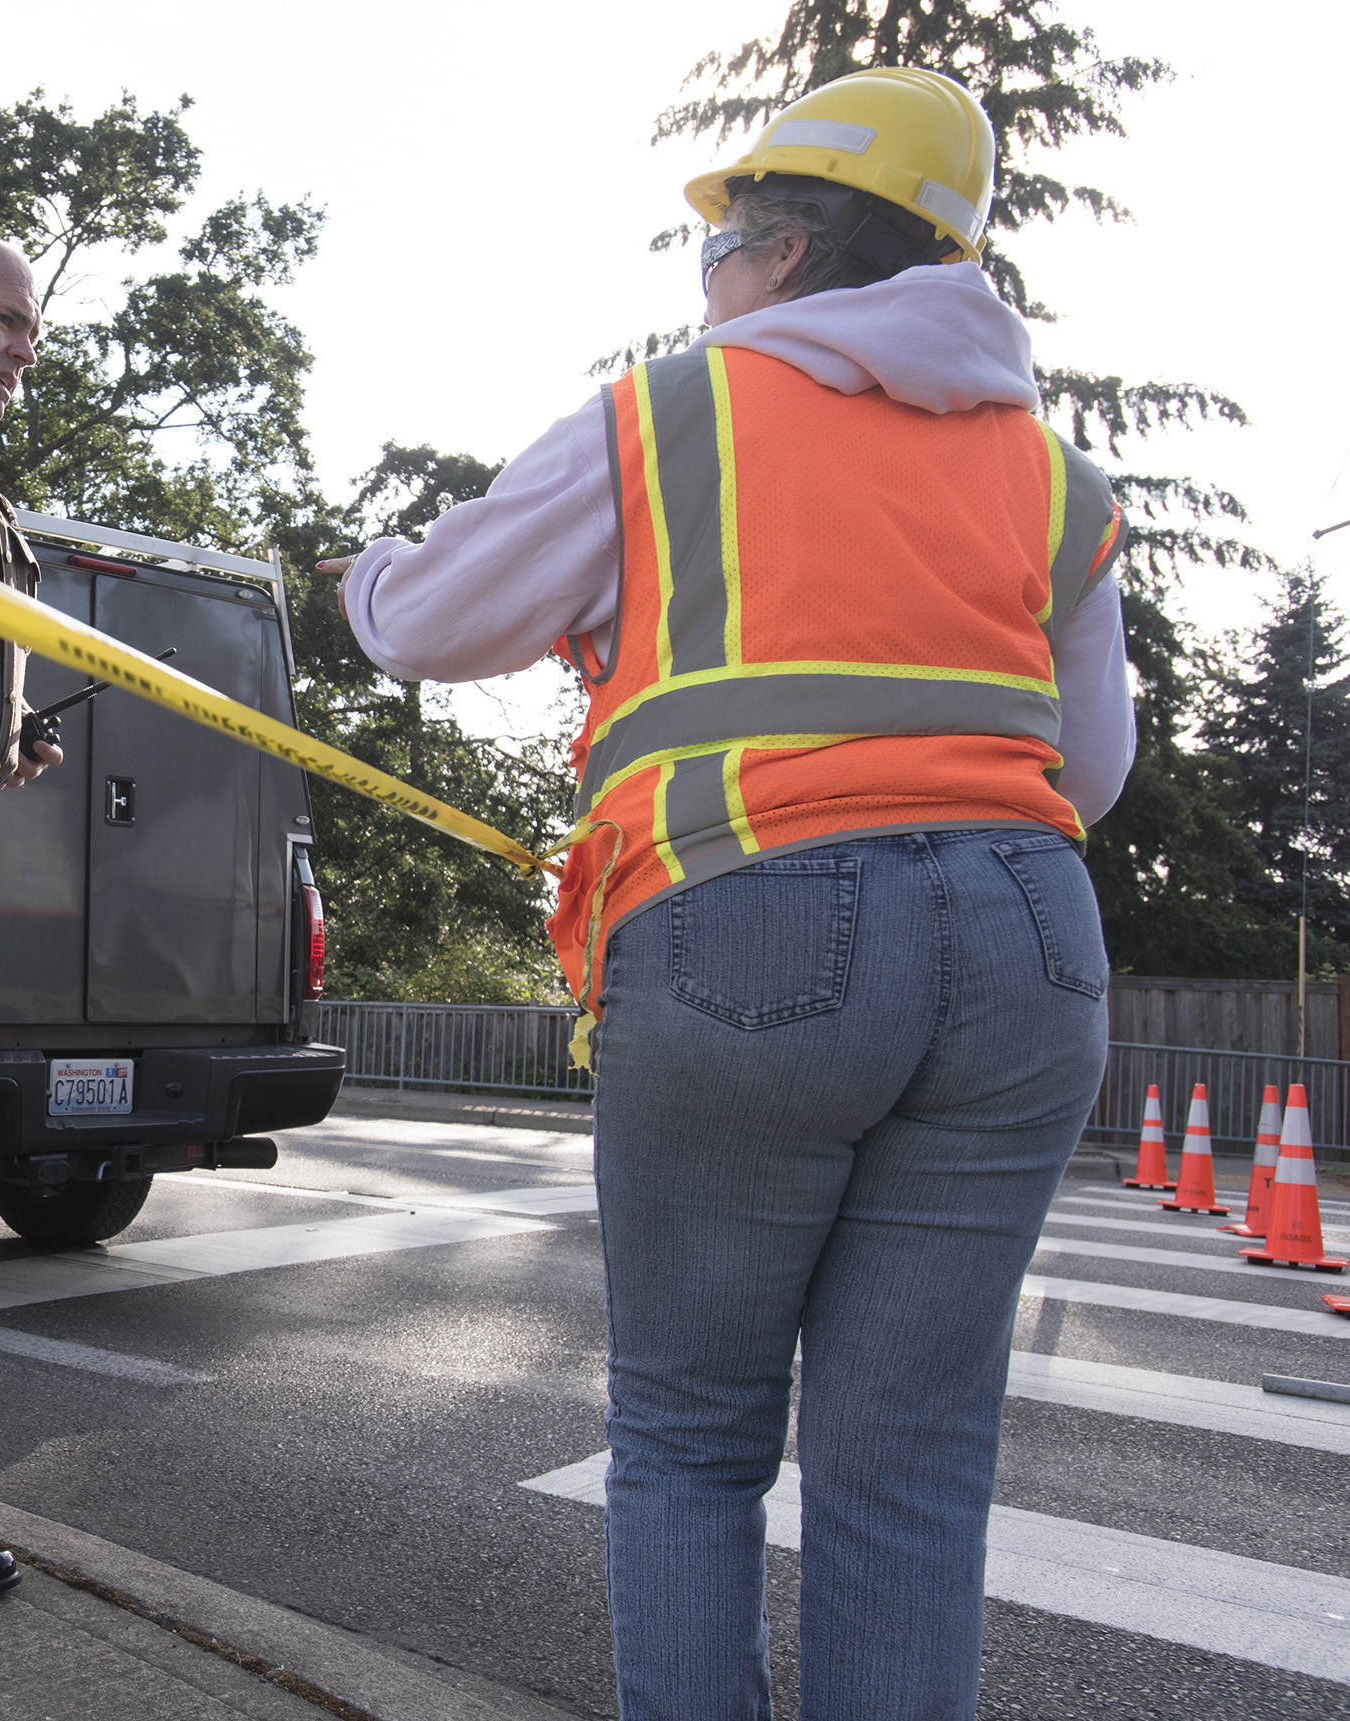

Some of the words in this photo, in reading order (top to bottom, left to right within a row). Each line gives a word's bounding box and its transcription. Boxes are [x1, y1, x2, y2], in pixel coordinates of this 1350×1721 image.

[57, 1069, 102, 1077] WASHINGTON
[54, 1078, 128, 1106] C79501A
[1280, 1232, 1313, 1243] ROADS
